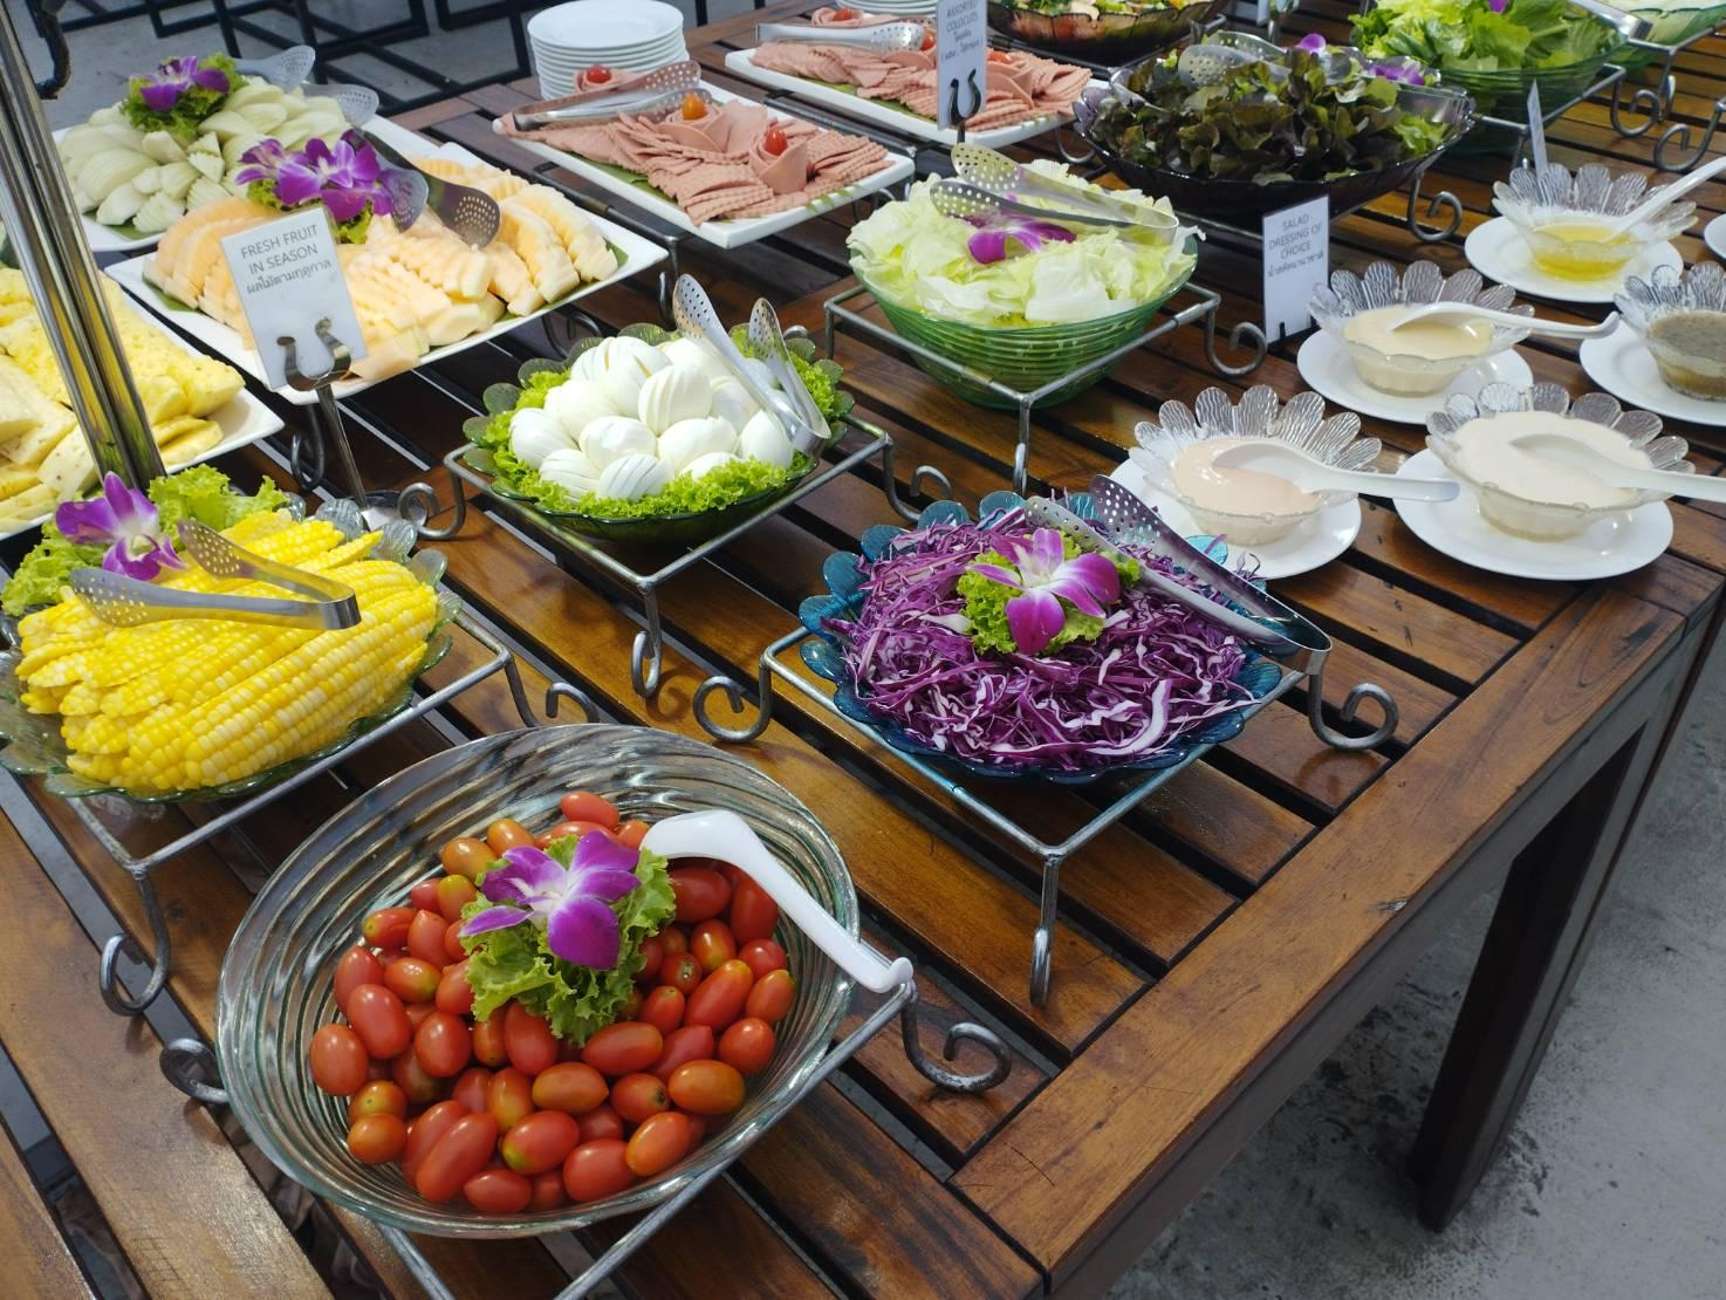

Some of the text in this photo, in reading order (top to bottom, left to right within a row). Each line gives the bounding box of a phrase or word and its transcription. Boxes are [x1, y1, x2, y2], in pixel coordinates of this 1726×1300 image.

[1282, 213, 1310, 231] SALAD
[241, 224, 318, 259] FRESH FRUIT
[1268, 227, 1310, 250] DRESSING
[1280, 240, 1311, 260] CHOICE
[248, 243, 318, 275] IN SEASON
